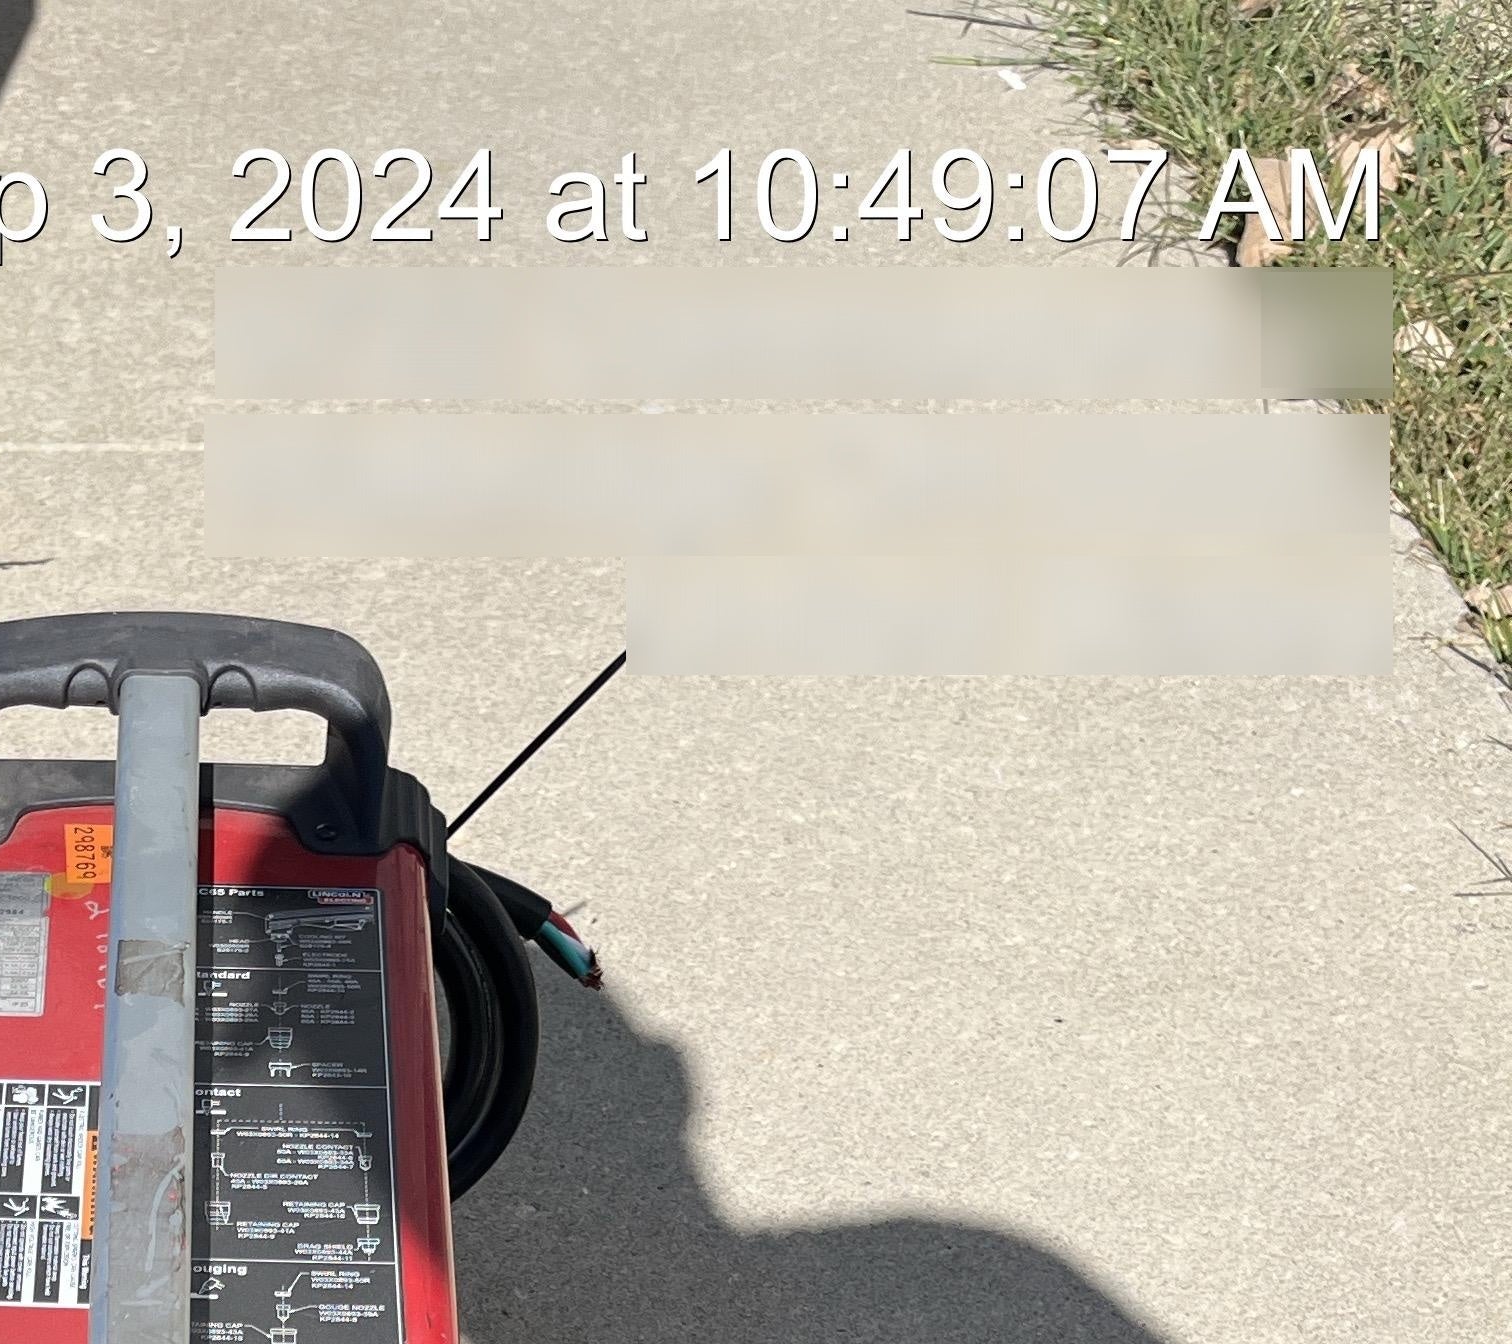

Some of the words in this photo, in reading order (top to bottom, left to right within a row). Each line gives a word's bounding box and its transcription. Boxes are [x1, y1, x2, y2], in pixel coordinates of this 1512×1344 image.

[73, 827, 97, 880] 298769
[198, 888, 225, 896] C65
[229, 888, 264, 897] Parts
[196, 970, 250, 980] tandard
[195, 1088, 242, 1097] ontact
[192, 1263, 248, 1276] ouging
